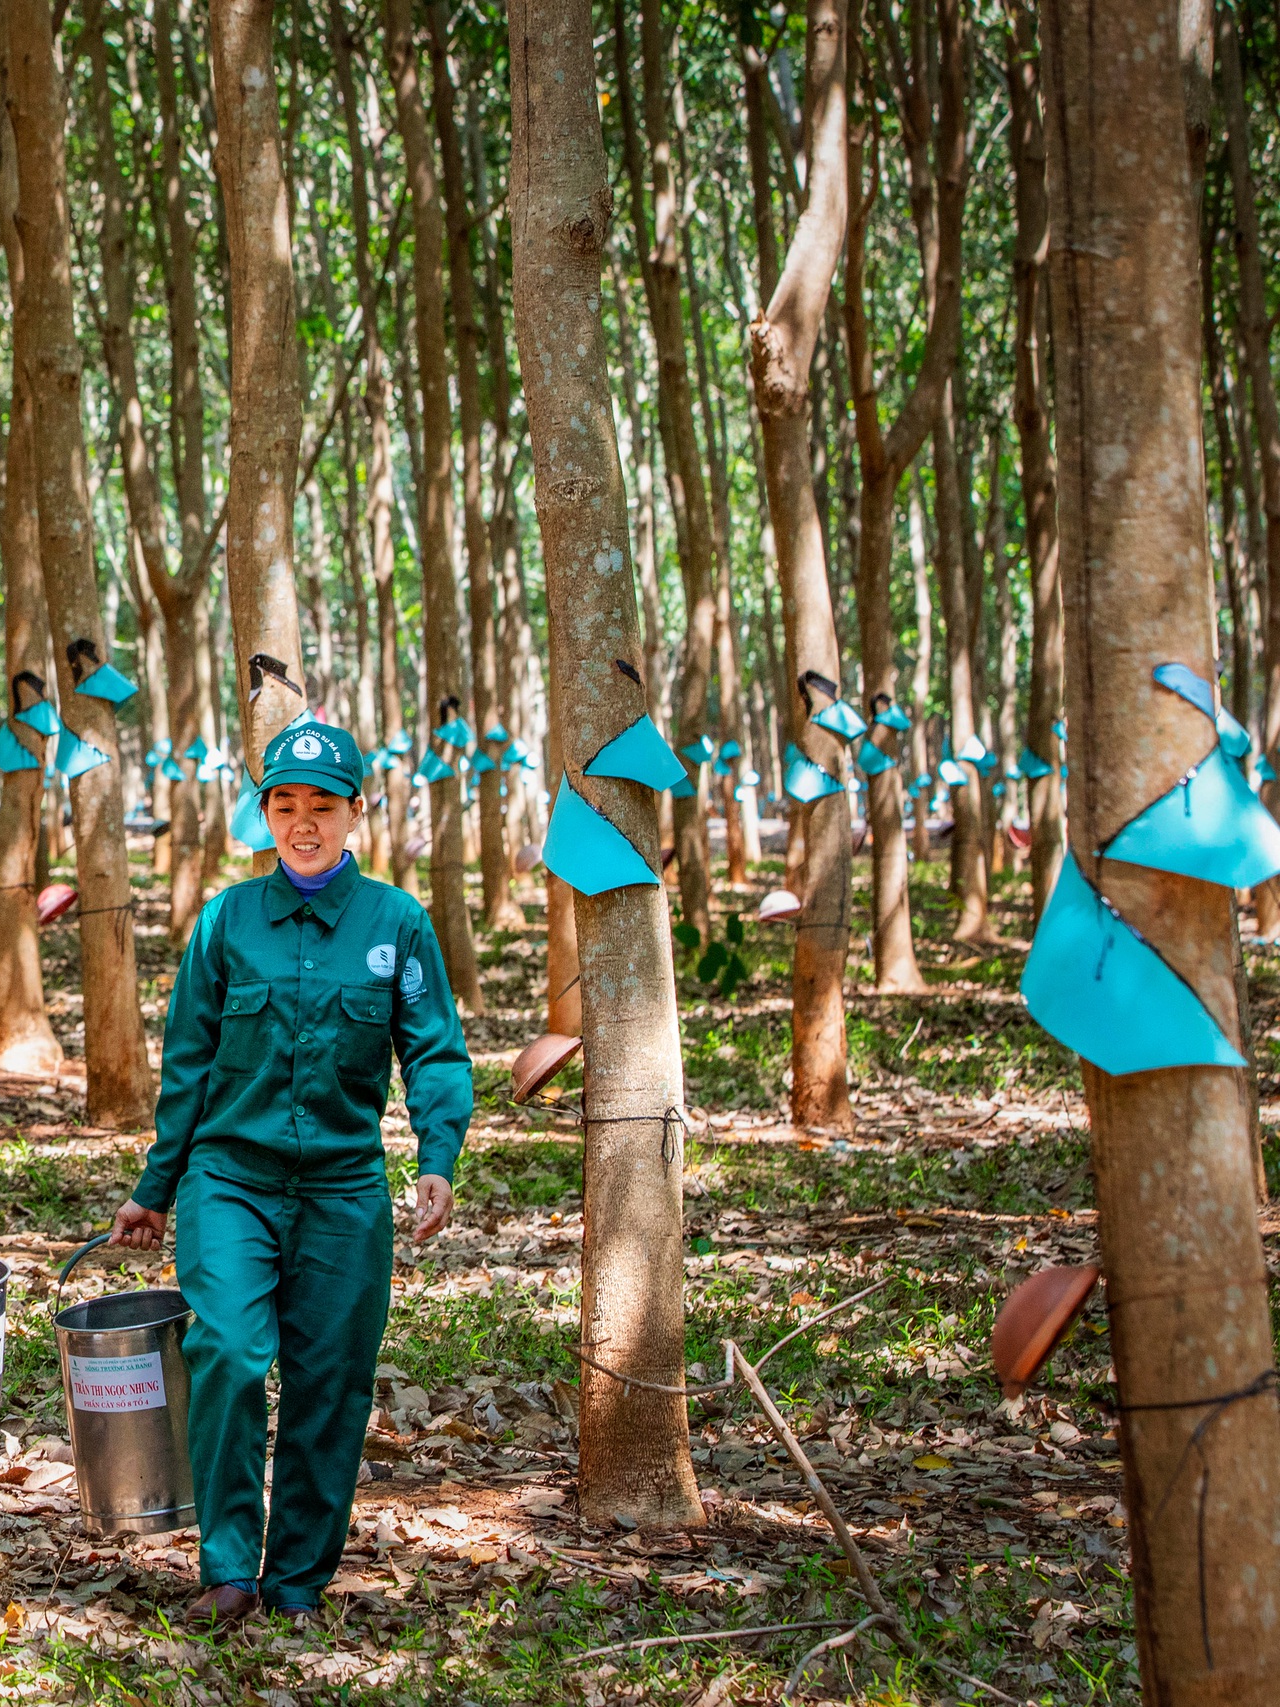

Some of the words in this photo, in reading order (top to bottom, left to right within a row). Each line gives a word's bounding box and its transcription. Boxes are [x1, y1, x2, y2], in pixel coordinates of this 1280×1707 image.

[274, 742, 286, 761] CÔNG
[306, 729, 320, 738] CAO
[321, 735, 330, 744] SU
[91, 1385, 104, 1398] THỊ
[104, 1384, 128, 1398] NGỌC
[129, 1380, 159, 1395] NHUNG
[116, 1399, 126, 1408] SỐ
[133, 1397, 143, 1406] TỔ
